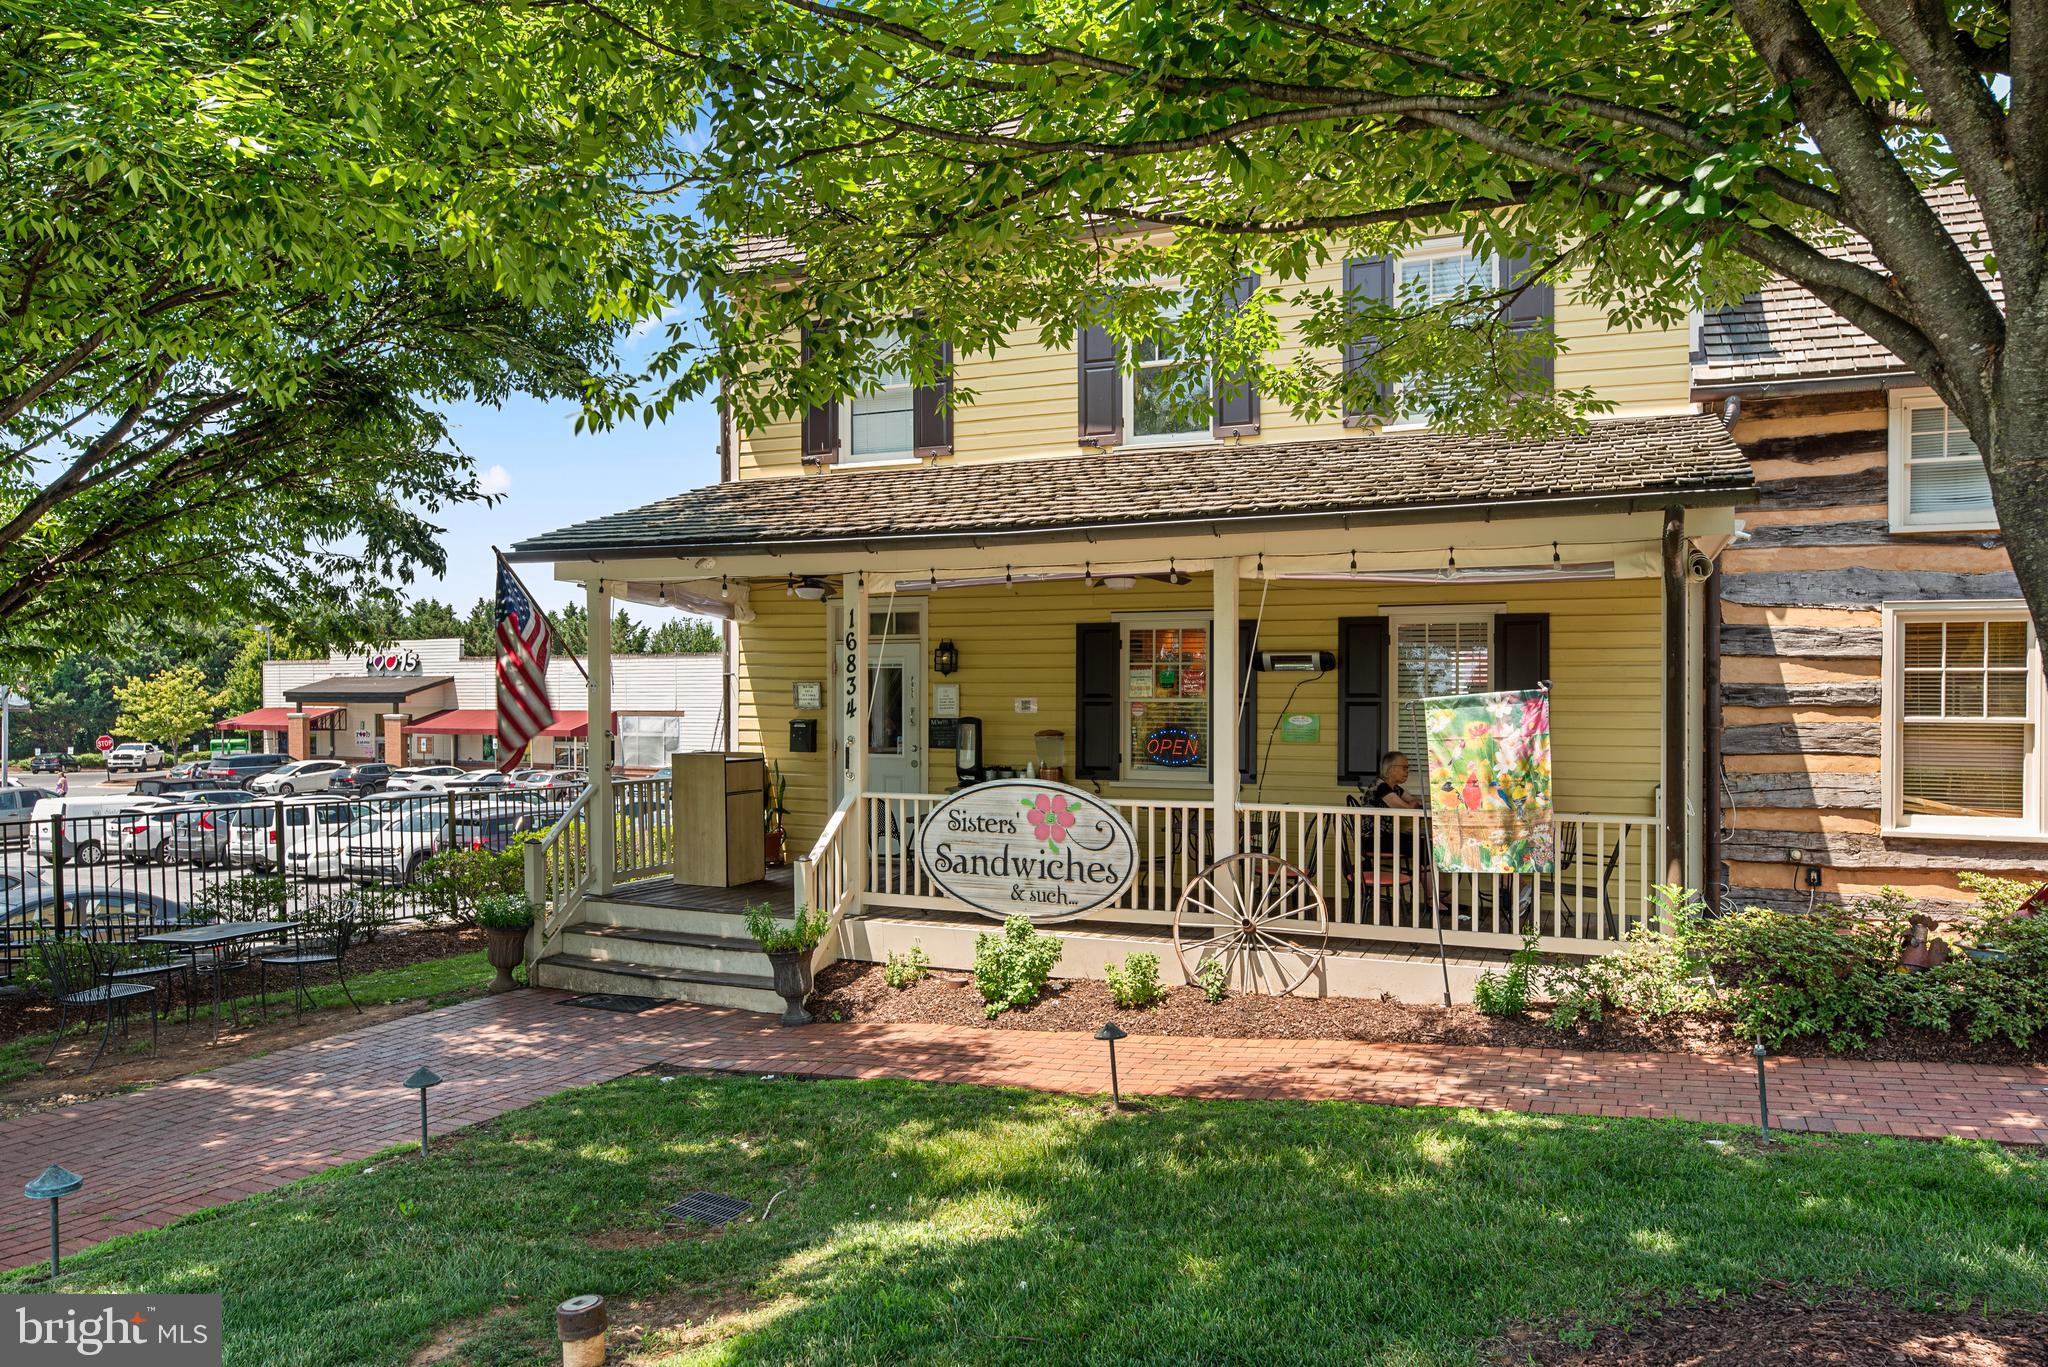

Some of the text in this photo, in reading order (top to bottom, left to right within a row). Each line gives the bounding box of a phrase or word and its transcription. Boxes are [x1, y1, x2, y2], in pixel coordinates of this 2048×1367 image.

[846, 608, 857, 719] 16834
[97, 739, 113, 748] STOP
[1147, 738, 1199, 756] OPEN
[947, 808, 1020, 835] Sisters'
[934, 843, 1119, 885] Sandwiches
[1010, 883, 1079, 906] & such...
